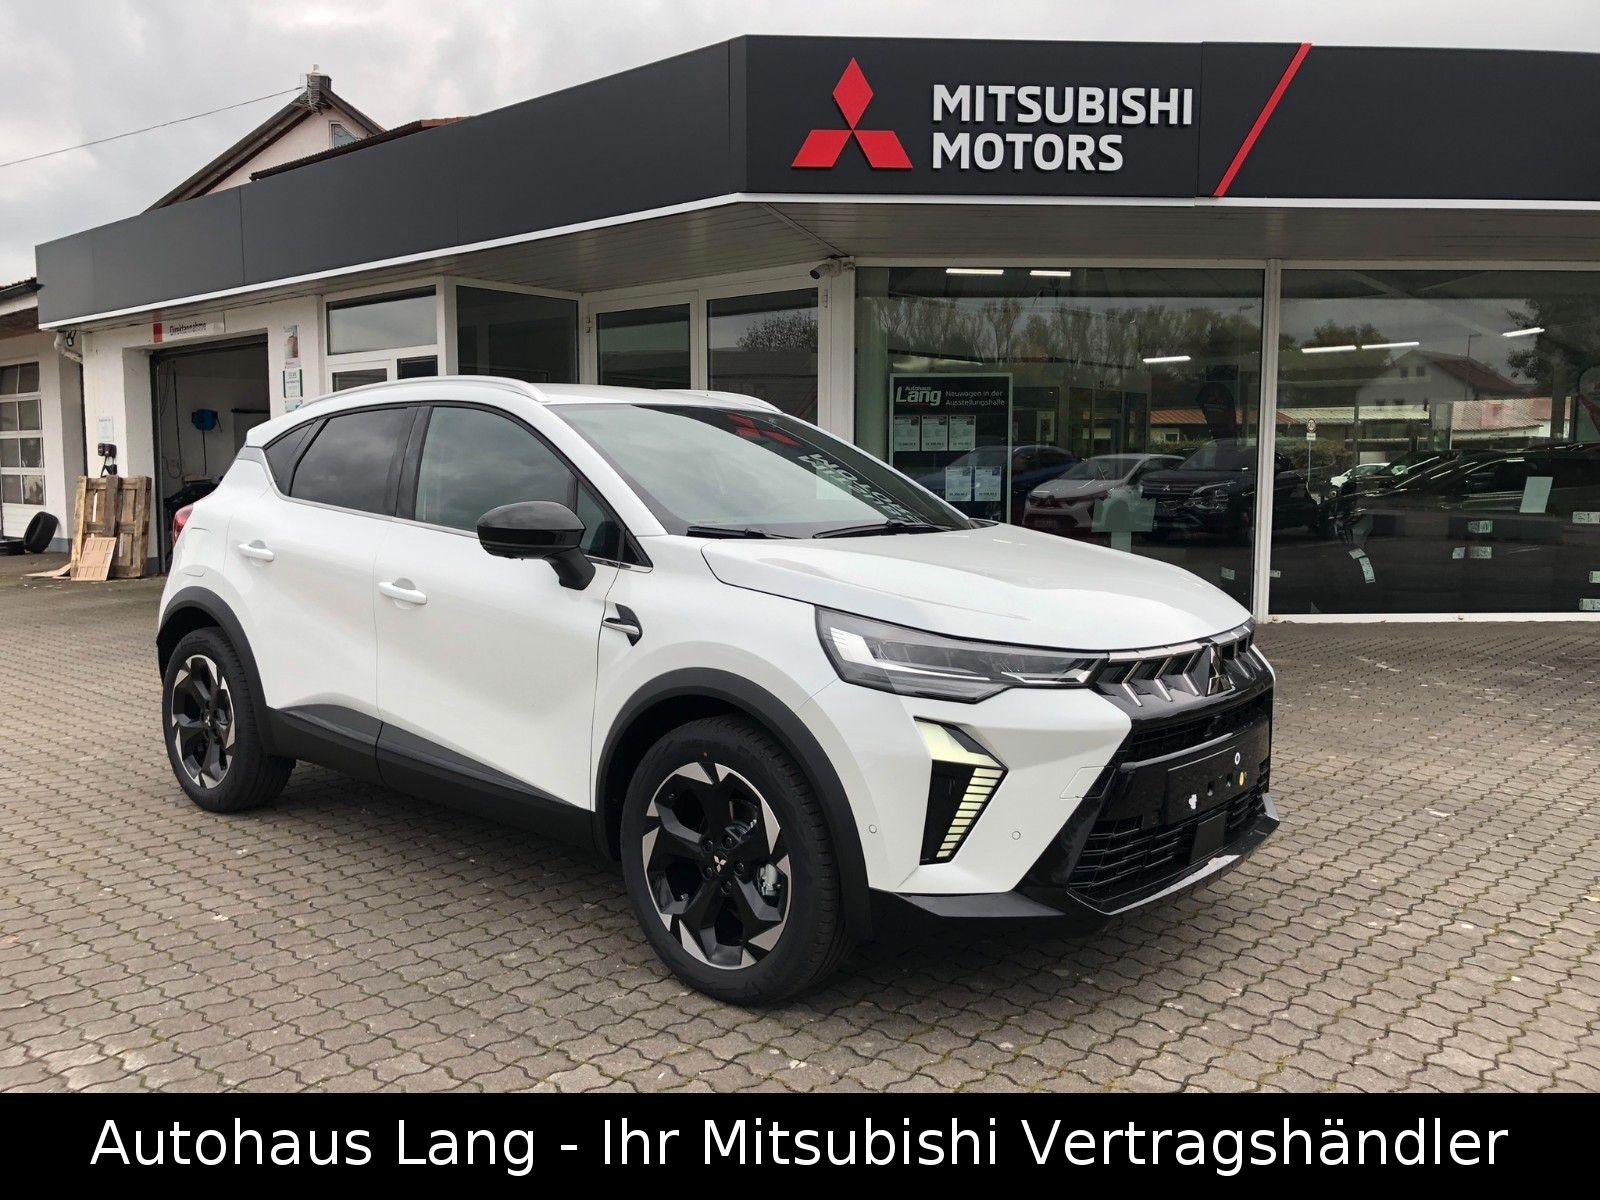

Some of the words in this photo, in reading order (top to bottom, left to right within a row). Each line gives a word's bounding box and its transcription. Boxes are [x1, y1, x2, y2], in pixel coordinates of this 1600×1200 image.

[933, 84, 1193, 125] MITSUBISHI
[933, 132, 1124, 172] MOTORS
[896, 386, 942, 406] Lang
[945, 390, 982, 398] Neuwagen
[945, 399, 1005, 407] Ausstellungshalle
